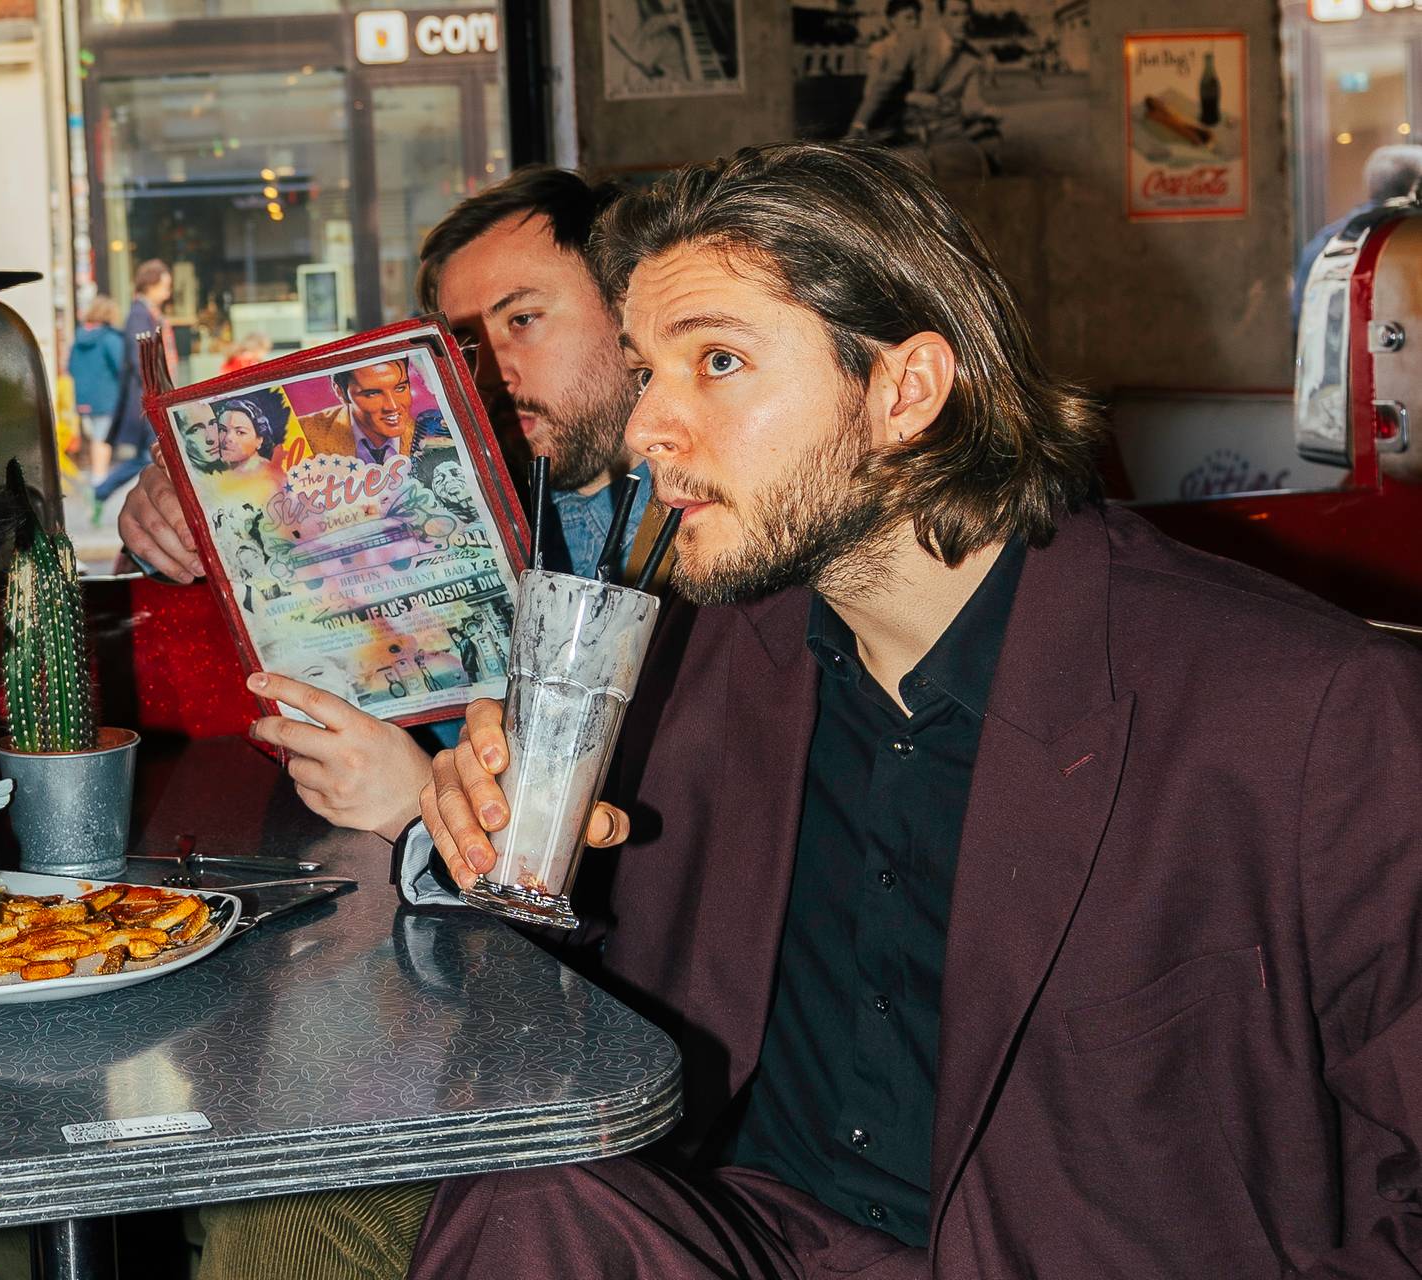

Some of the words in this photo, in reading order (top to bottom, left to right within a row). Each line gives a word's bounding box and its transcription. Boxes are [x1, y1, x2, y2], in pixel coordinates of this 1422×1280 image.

[299, 473, 325, 488] The
[340, 570, 381, 587] BERLIN
[443, 564, 468, 578] BAR
